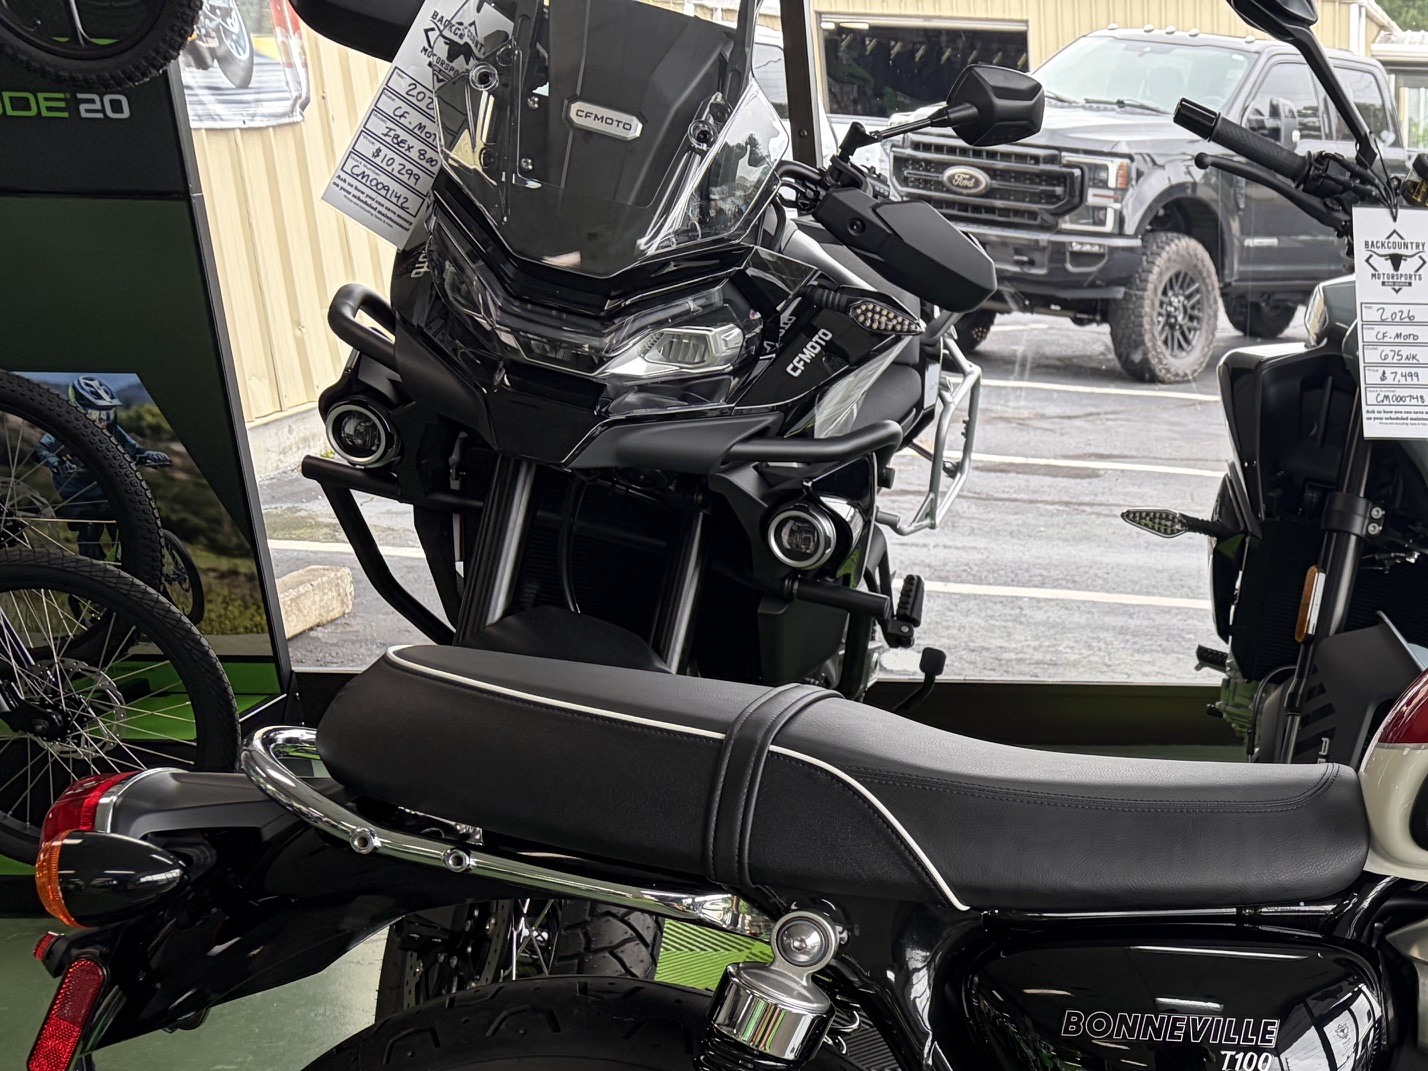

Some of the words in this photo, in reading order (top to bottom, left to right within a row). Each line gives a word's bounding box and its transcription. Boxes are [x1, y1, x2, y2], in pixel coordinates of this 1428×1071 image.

[0, 91, 70, 118] DE
[76, 93, 131, 119] 20
[405, 82, 436, 111] 202
[575, 109, 632, 131] CFMOTO
[381, 125, 415, 153] IBEX
[372, 147, 421, 186] $10,299
[952, 173, 976, 188] Ford
[350, 164, 410, 210] CM009142
[1364, 240, 1426, 251] BACKCOUNTRY
[1371, 272, 1422, 281] MOTORSPORTS
[1376, 307, 1416, 321] 2026
[785, 328, 833, 378] CFMOTO
[1060, 1009, 1280, 1048] BONNEVILLE
